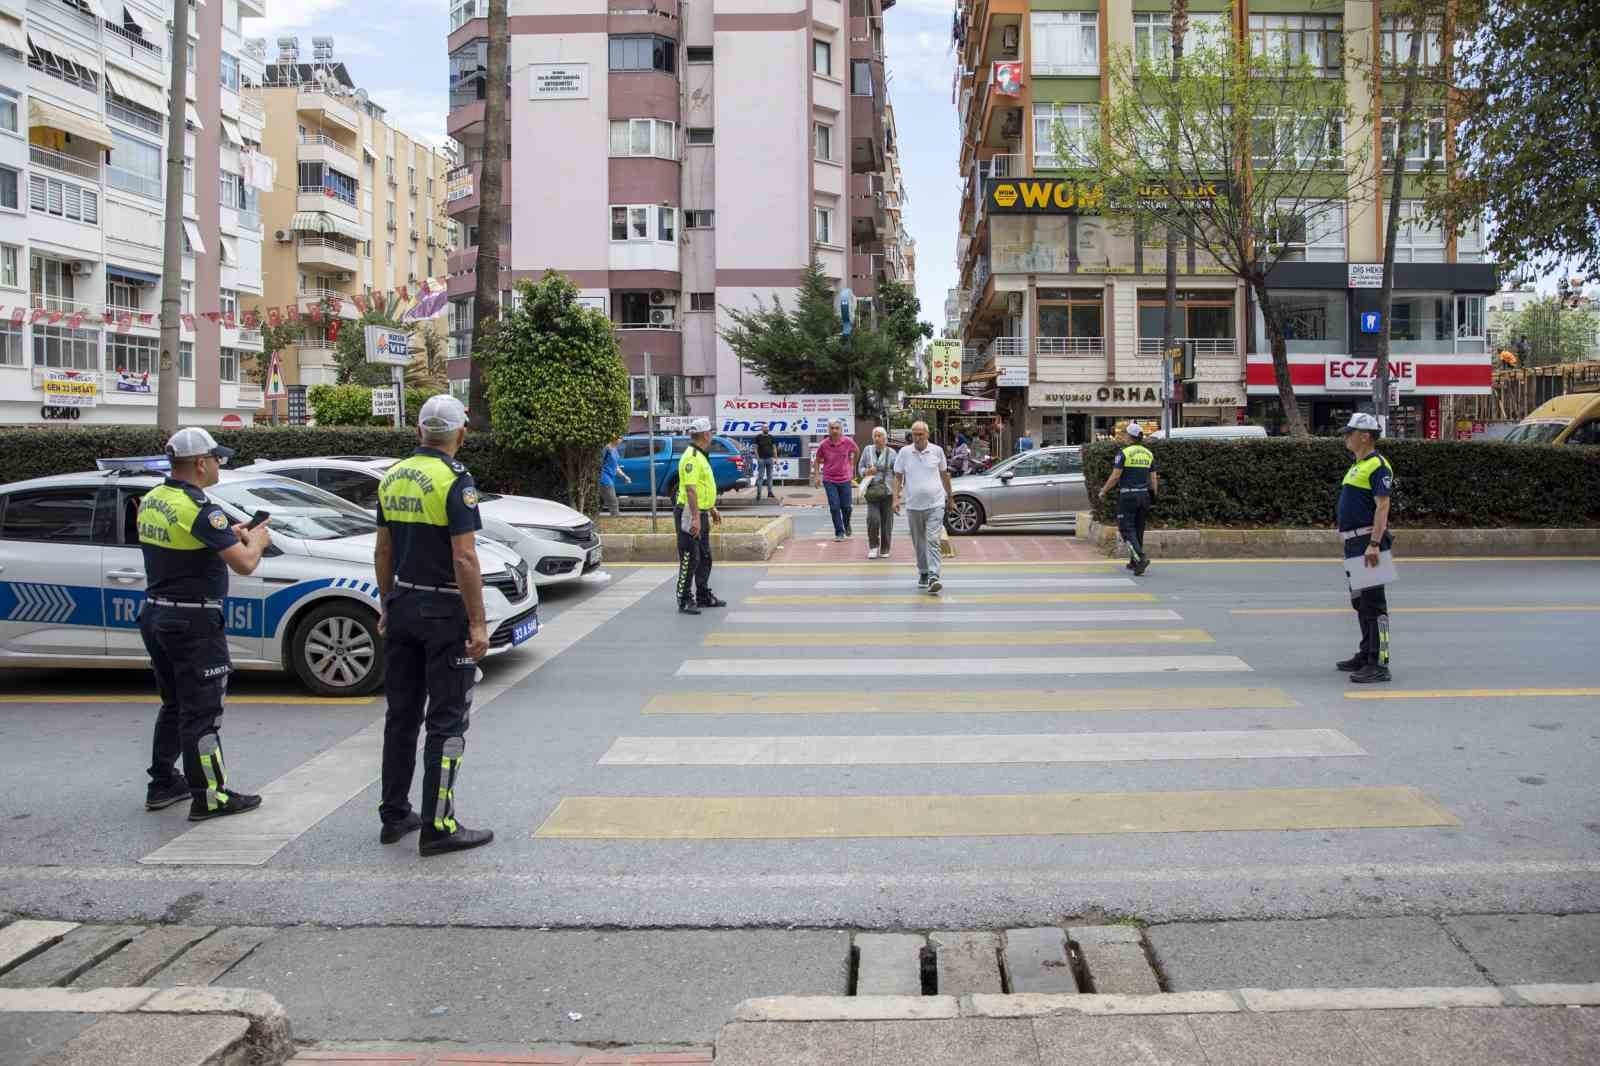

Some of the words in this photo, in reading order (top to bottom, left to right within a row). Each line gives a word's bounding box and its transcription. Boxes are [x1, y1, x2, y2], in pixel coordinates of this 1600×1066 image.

[1365, 266, 1384, 274] HEKİ
[1329, 361, 1412, 378] ECZANE
[1096, 387, 1163, 402] ORHA
[723, 398, 799, 409] AKDENİZ
[41, 406, 80, 419] CEMO
[1429, 409, 1437, 439] ECZ
[384, 496, 425, 513] ZABITA
[112, 597, 146, 622] TRA
[225, 601, 252, 629] İSİ
[204, 665, 230, 677] ZABITA
